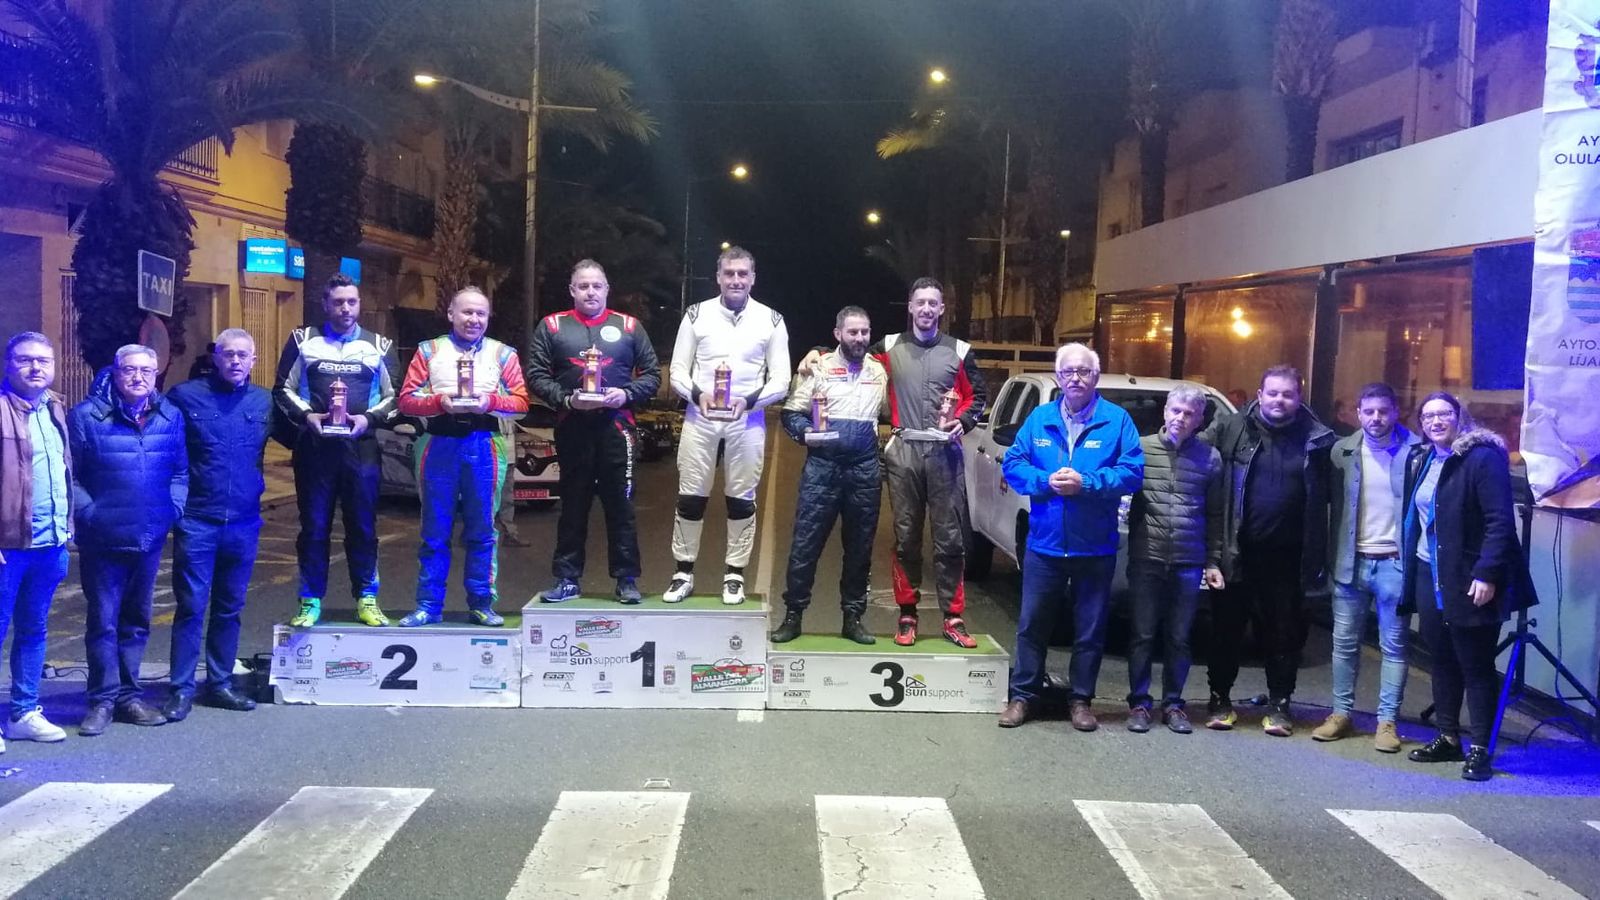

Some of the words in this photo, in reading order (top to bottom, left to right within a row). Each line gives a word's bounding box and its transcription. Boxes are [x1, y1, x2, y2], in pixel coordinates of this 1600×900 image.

[142, 271, 172, 297] TAXI
[1558, 338, 1600, 350] AYTO.
[318, 361, 361, 372] ASTARS
[379, 644, 418, 690] 2
[630, 641, 656, 688] 1
[693, 677, 748, 690] ALMANZORA
[697, 674, 724, 683] VALLE
[868, 661, 905, 708] 3
